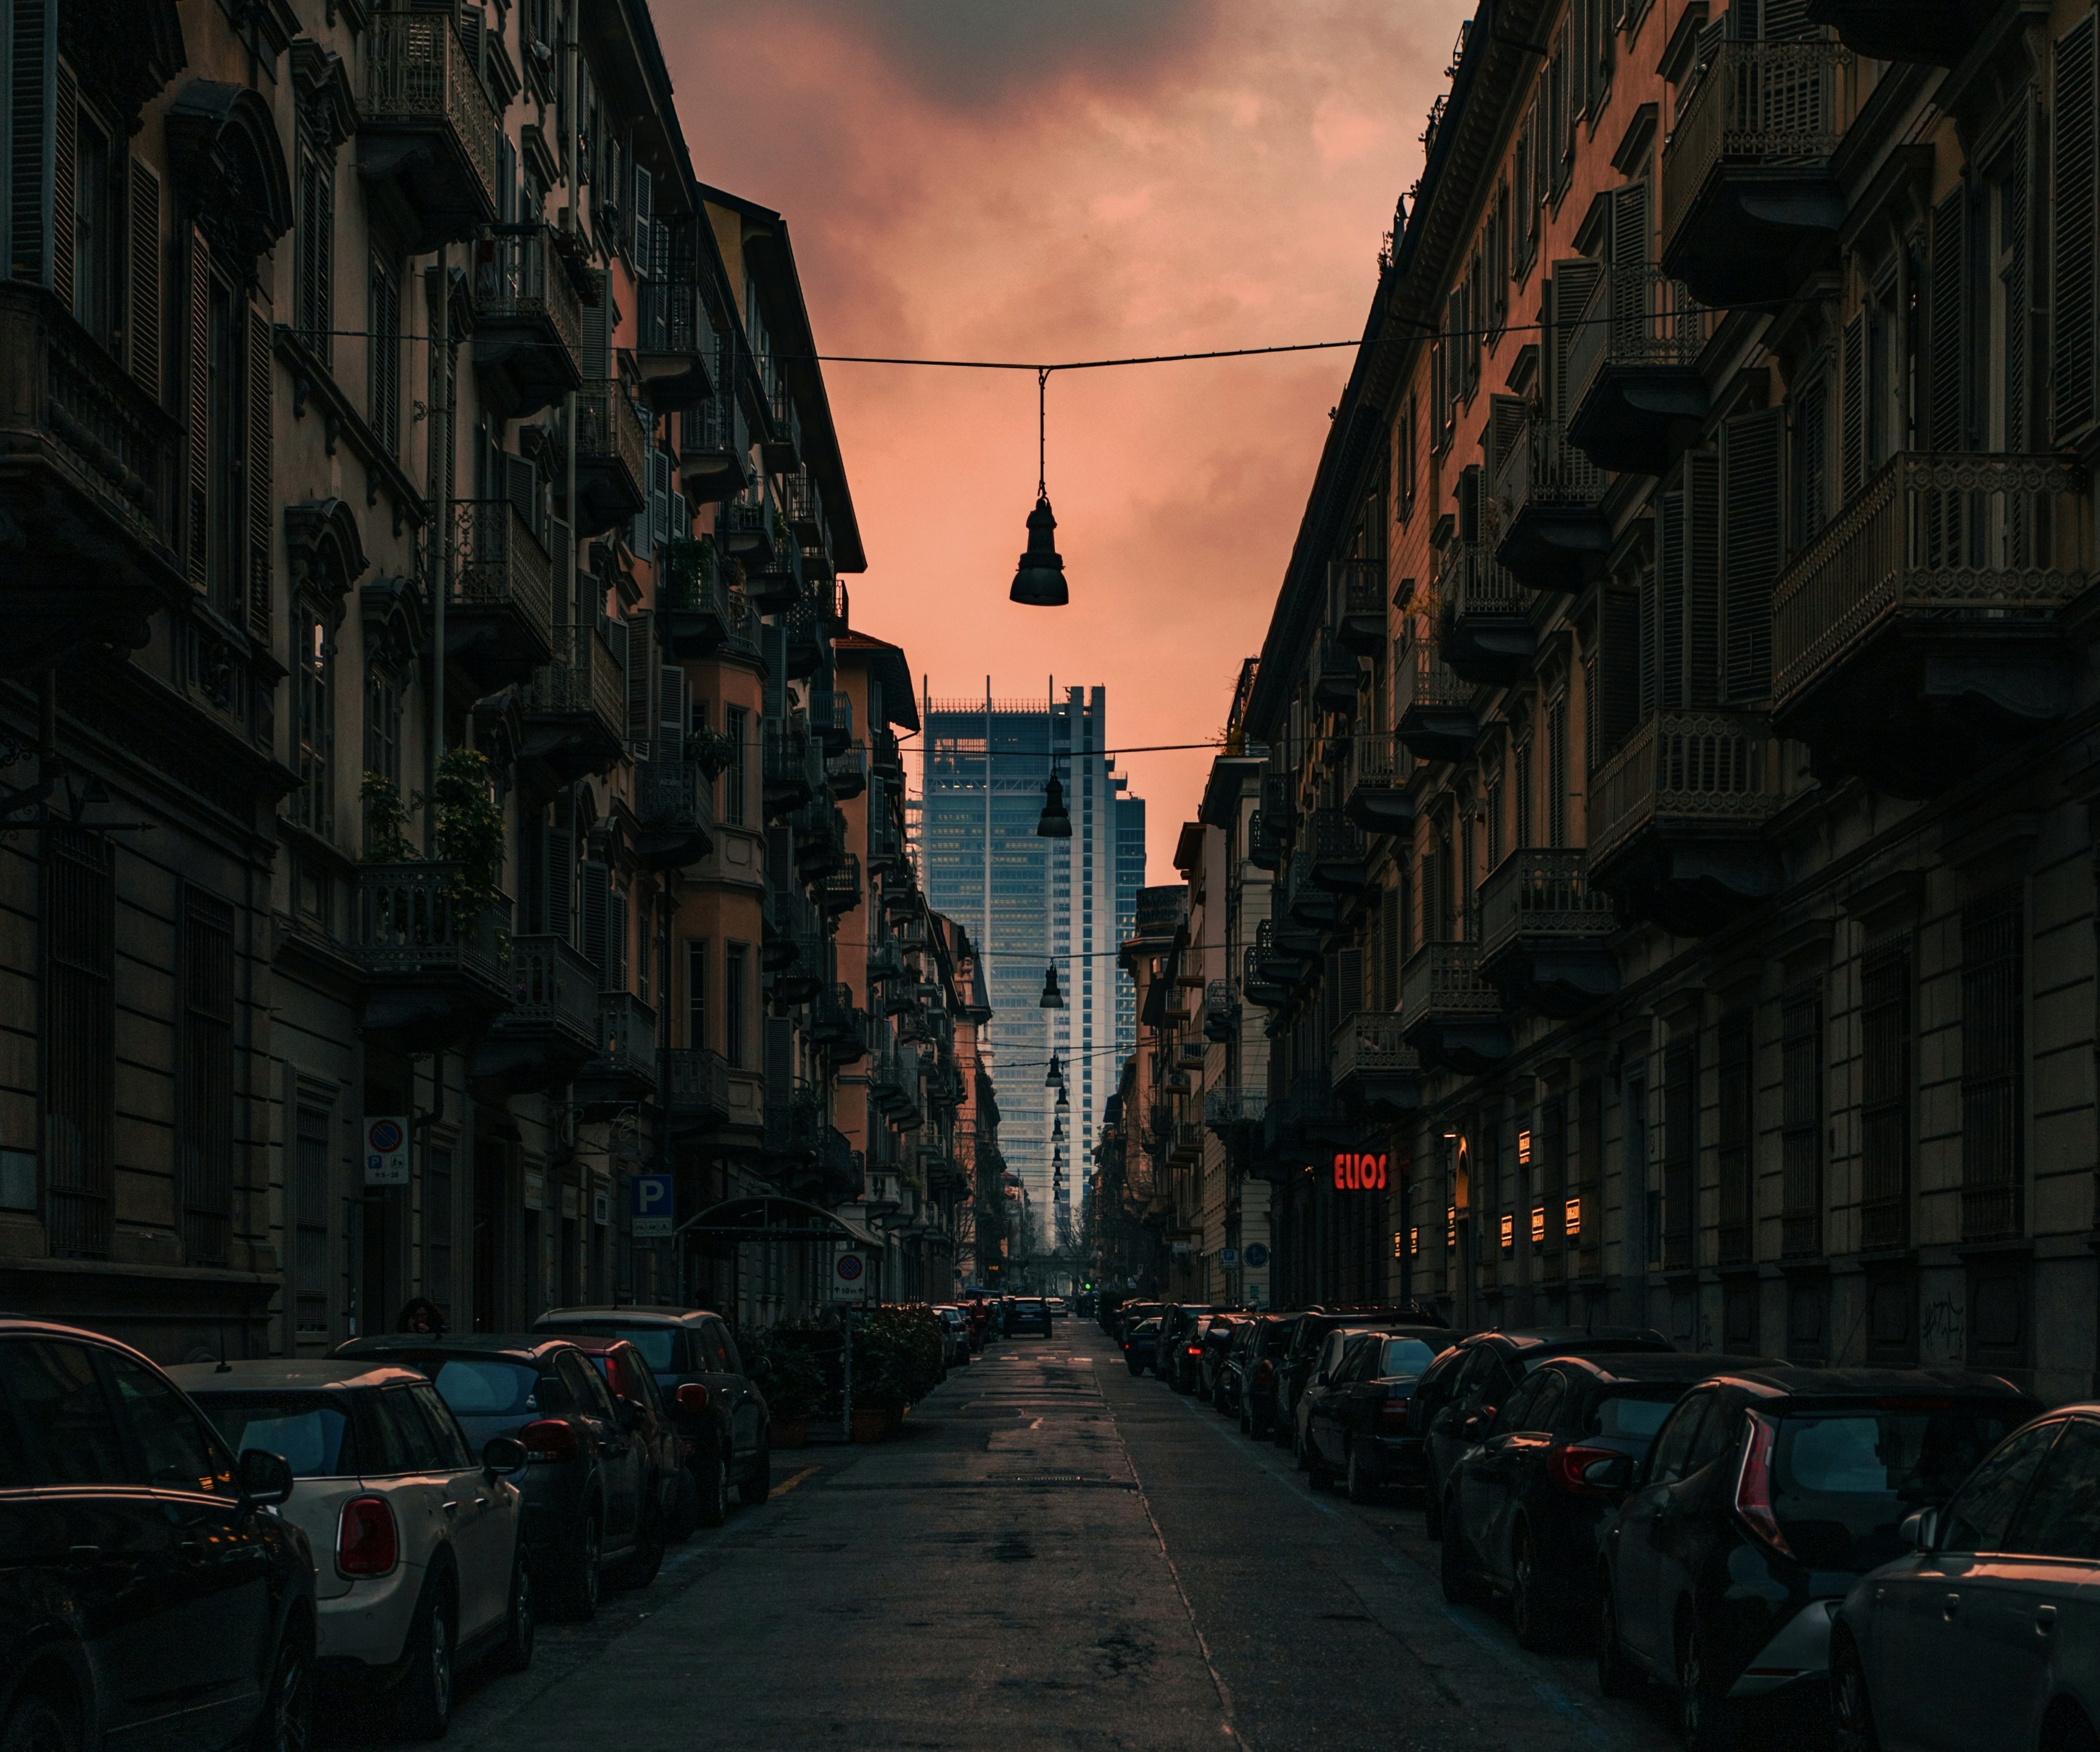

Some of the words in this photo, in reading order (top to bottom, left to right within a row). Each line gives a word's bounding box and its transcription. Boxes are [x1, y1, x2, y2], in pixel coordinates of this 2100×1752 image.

[371, 1157, 379, 1167] P
[1334, 1153, 1387, 1190] ELIOS
[639, 1180, 665, 1213] P
